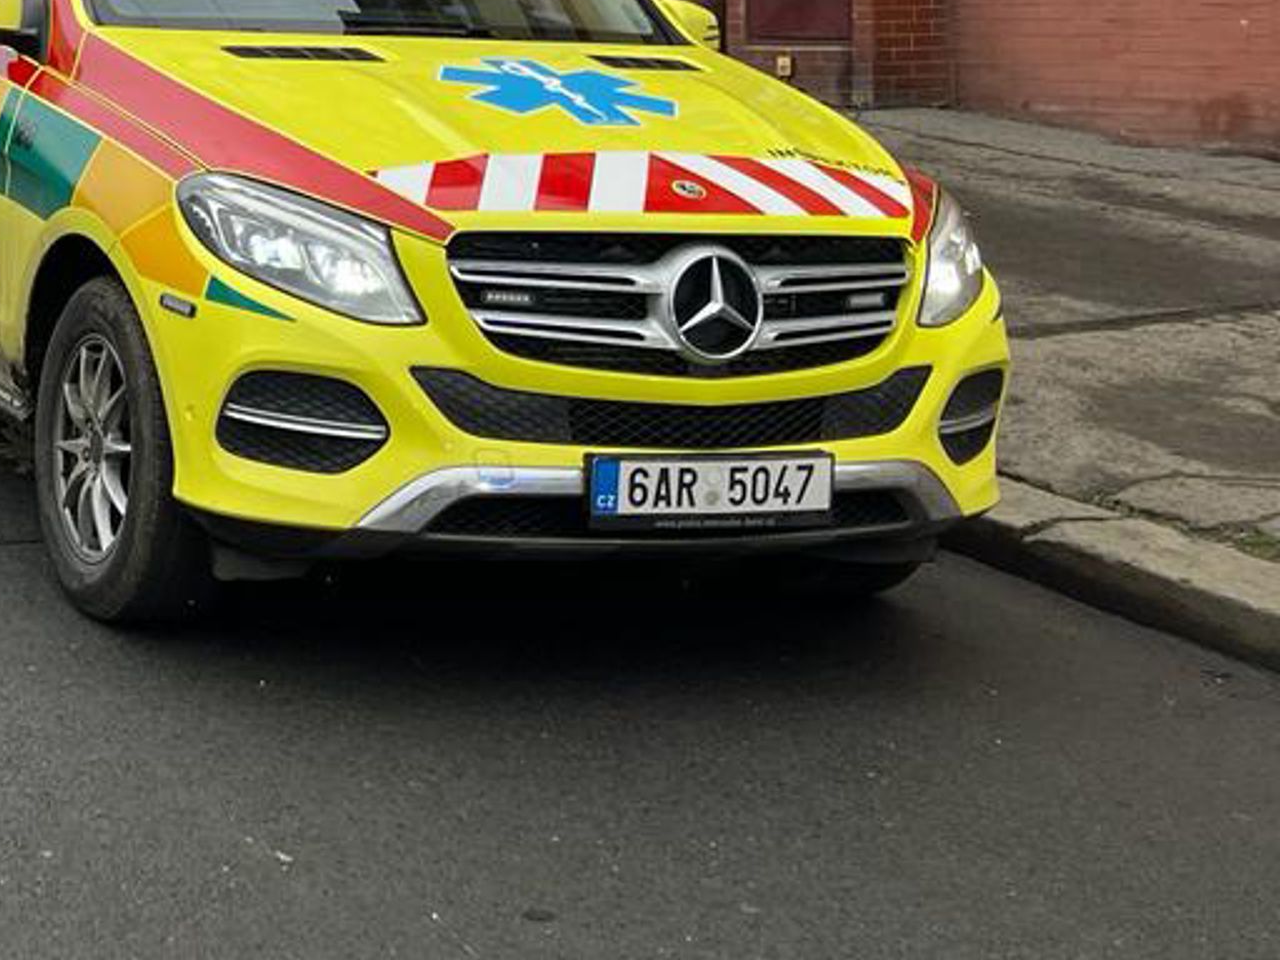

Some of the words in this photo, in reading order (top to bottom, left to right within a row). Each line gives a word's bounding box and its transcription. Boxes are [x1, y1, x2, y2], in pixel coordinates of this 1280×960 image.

[627, 467, 698, 508] 6AR
[728, 464, 814, 506] 5047
[596, 494, 615, 508] CZ
